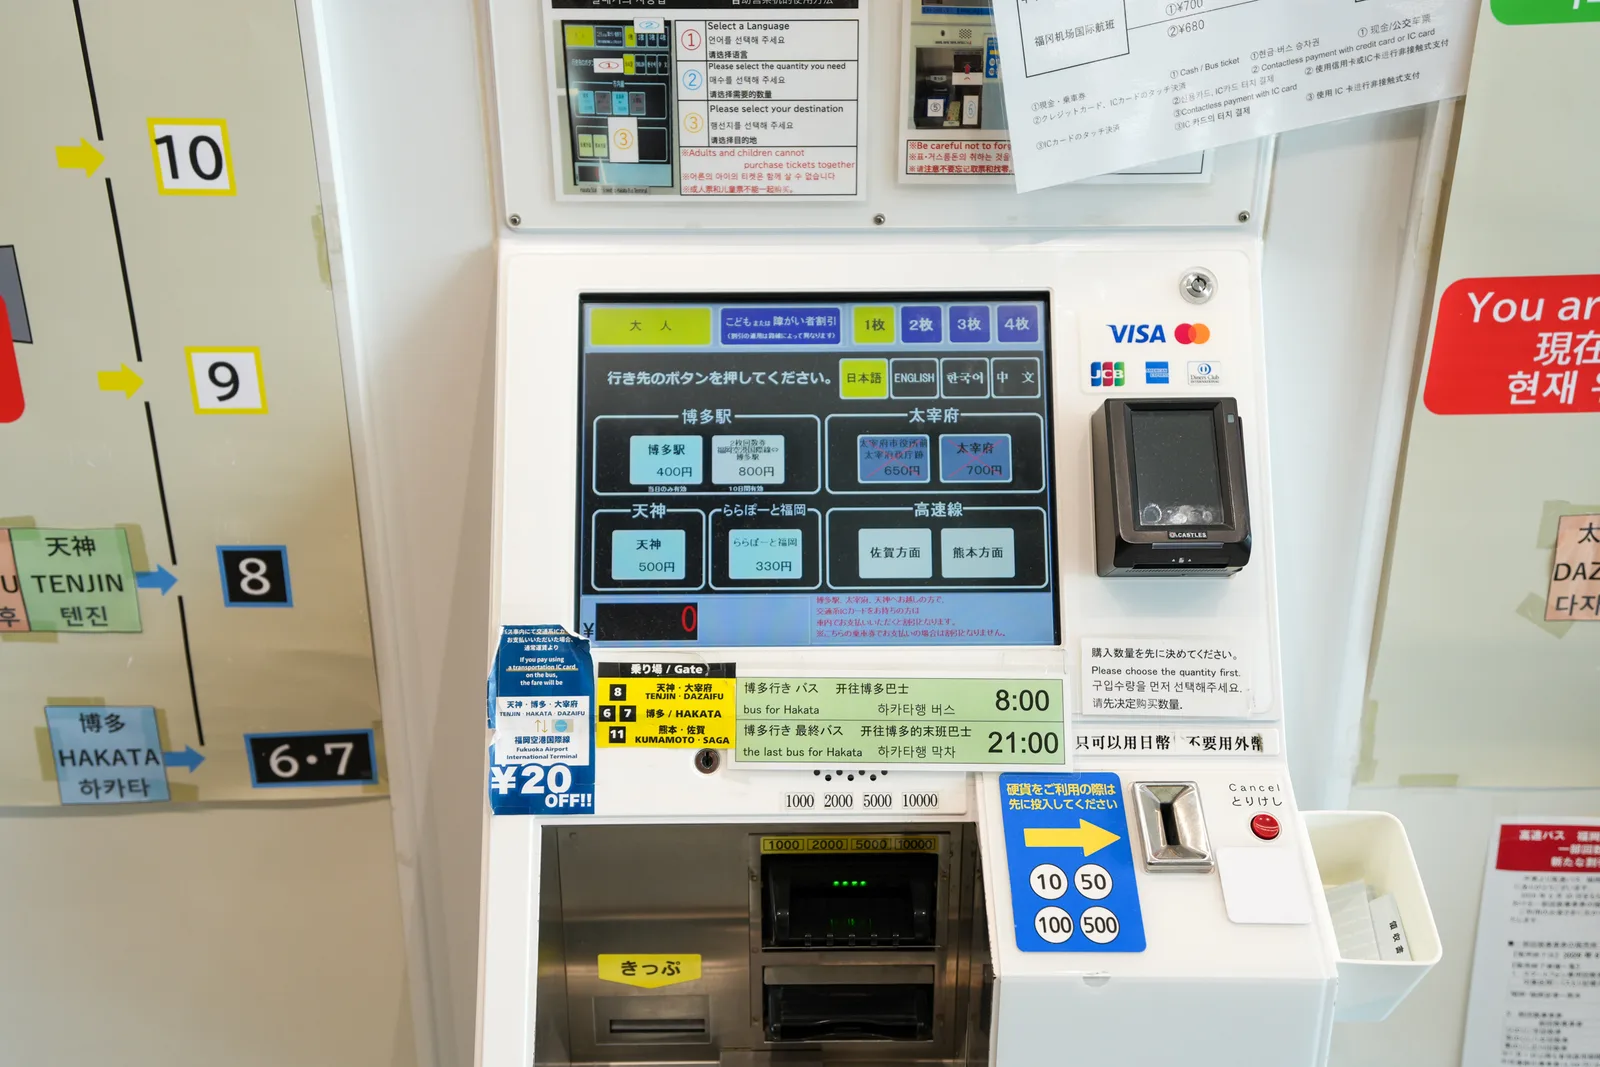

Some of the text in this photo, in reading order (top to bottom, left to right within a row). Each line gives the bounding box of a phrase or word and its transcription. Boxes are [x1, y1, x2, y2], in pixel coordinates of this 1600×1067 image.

[708, 22, 737, 30] Select
[747, 22, 790, 31] Language
[709, 50, 748, 59] 请选择语言
[1180, 57, 1240, 76] Cash Bus ticket
[710, 90, 772, 98] 请选择需要的数量
[771, 106, 790, 114] your
[155, 135, 223, 180] 10
[1467, 292, 1545, 323] You
[864, 317, 1029, 331] 1枚 2枚 3枚 4枚
[1106, 324, 1166, 343] VISA
[208, 361, 240, 401] 9
[607, 370, 832, 386] 行き先のボタンを押してください。
[846, 372, 882, 385] 日本語
[894, 372, 935, 383] ENGLISH
[946, 371, 984, 385] 한국어
[1508, 370, 1578, 404] 현재
[682, 408, 732, 424] 博多駅
[909, 407, 959, 424] 太宰府
[648, 444, 686, 456] 博多駅
[957, 442, 994, 454] 太宰府
[656, 466, 693, 478] 400円
[739, 467, 774, 476] 800円
[884, 465, 920, 476] 650円
[967, 465, 1002, 475] 700円
[632, 503, 666, 518] 天神
[723, 503, 806, 517] ららぽーと福岡
[914, 502, 963, 518] 高速線
[45, 537, 96, 556] 天神
[636, 539, 661, 551] 天神
[870, 546, 920, 559] 佐賀方面
[952, 546, 1003, 559] 熊本方面
[638, 561, 675, 573] 500円
[756, 561, 792, 572] 330円
[239, 558, 270, 595] 8
[31, 574, 124, 593] TENJIN
[60, 606, 108, 628] 텐진
[681, 605, 697, 632] 0
[1092, 648, 1237, 660] 購入数量を先に決めてください。
[631, 664, 703, 674] 乗り場 Gate
[1092, 666, 1240, 678] Please choose the quantity first.
[614, 688, 621, 696] 8
[744, 682, 818, 694] 博多行き バス
[836, 684, 909, 694] 开往博多巴士
[1093, 681, 1242, 693] 구입수량을 먼저 선택해주세요.
[996, 690, 1049, 711] 8:00
[603, 709, 632, 717] 6 7
[646, 709, 664, 718] 博多
[744, 705, 819, 715] bus for Hakata
[878, 703, 955, 716] 하카타행 버스
[79, 713, 126, 733] 博多
[610, 730, 623, 738] 11
[744, 725, 843, 737] 博多行き 最終バス
[861, 726, 972, 738] 开往博多的末班巴士
[515, 736, 570, 744] 福岡空港国際線
[988, 732, 1058, 754] 21:00
[1076, 735, 1170, 750] 只可以用日幣
[59, 749, 160, 767] HAKATA
[743, 747, 862, 757] the last bus for Hakata
[878, 745, 956, 758] 하카타행 막차
[491, 765, 571, 794] ¥20
[79, 779, 150, 798] 하카타
[1007, 783, 1116, 796] 硬貨をご利用の際は
[1229, 783, 1280, 792] Cancel
[545, 794, 591, 808] OFF!!
[786, 794, 938, 808] 1000 2000 5000 10000
[1009, 799, 1117, 810] 先に投入してください
[1232, 796, 1282, 806] とりけし
[768, 840, 799, 849] 1000
[812, 840, 843, 849] 2000
[856, 840, 887, 849] 5000
[1037, 873, 1106, 890] 10 50
[1039, 917, 1117, 933] 100 500
[621, 961, 681, 976] きっぷ
